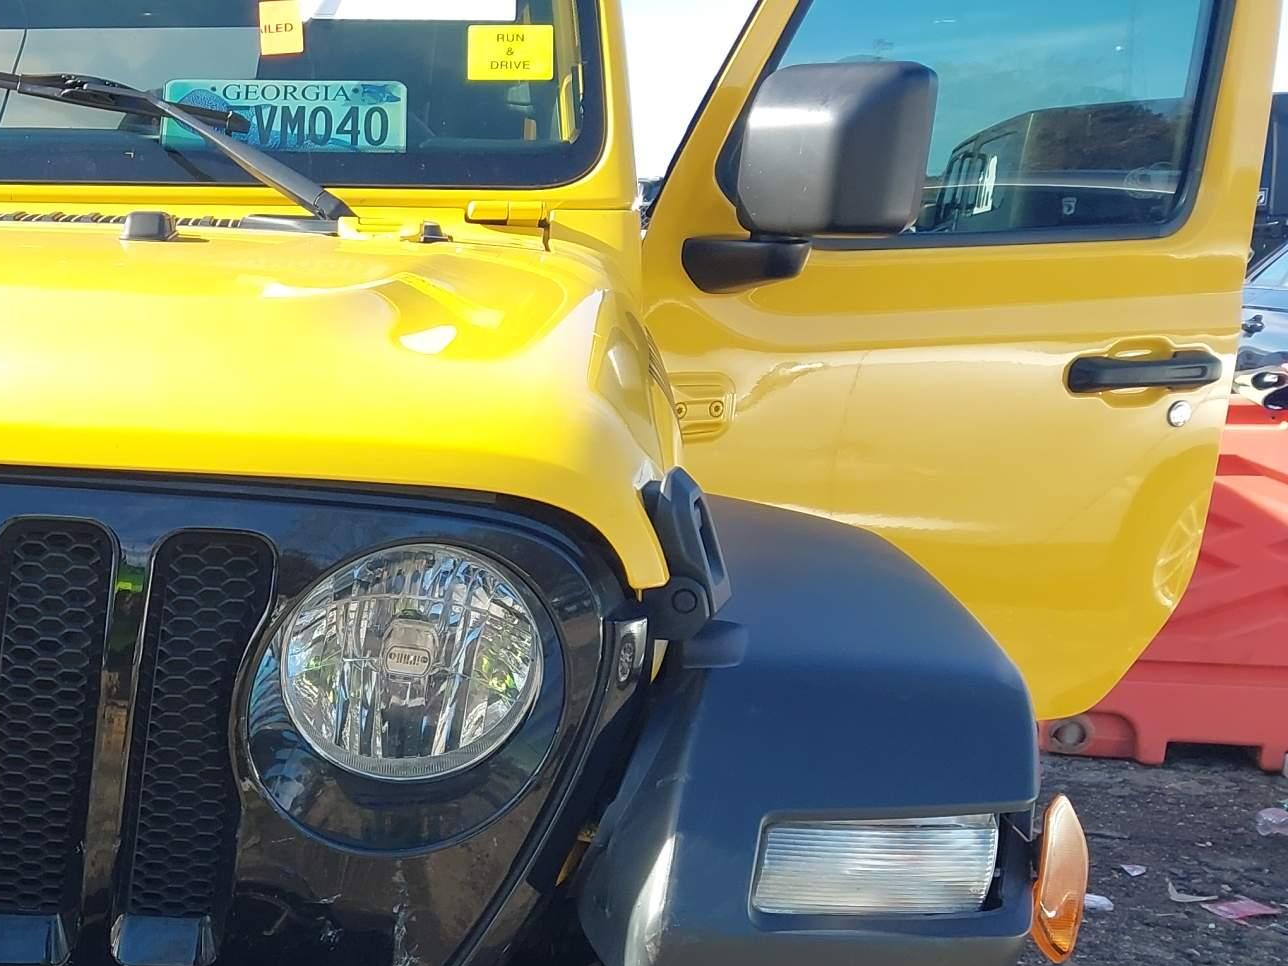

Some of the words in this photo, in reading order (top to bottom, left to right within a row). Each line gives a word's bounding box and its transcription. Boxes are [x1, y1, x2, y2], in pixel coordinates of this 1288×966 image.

[261, 22, 294, 34] ILED
[496, 33, 525, 42] RUN
[506, 47, 514, 56] &
[490, 60, 530, 70] DRIVE
[222, 84, 350, 101] GEORGIA
